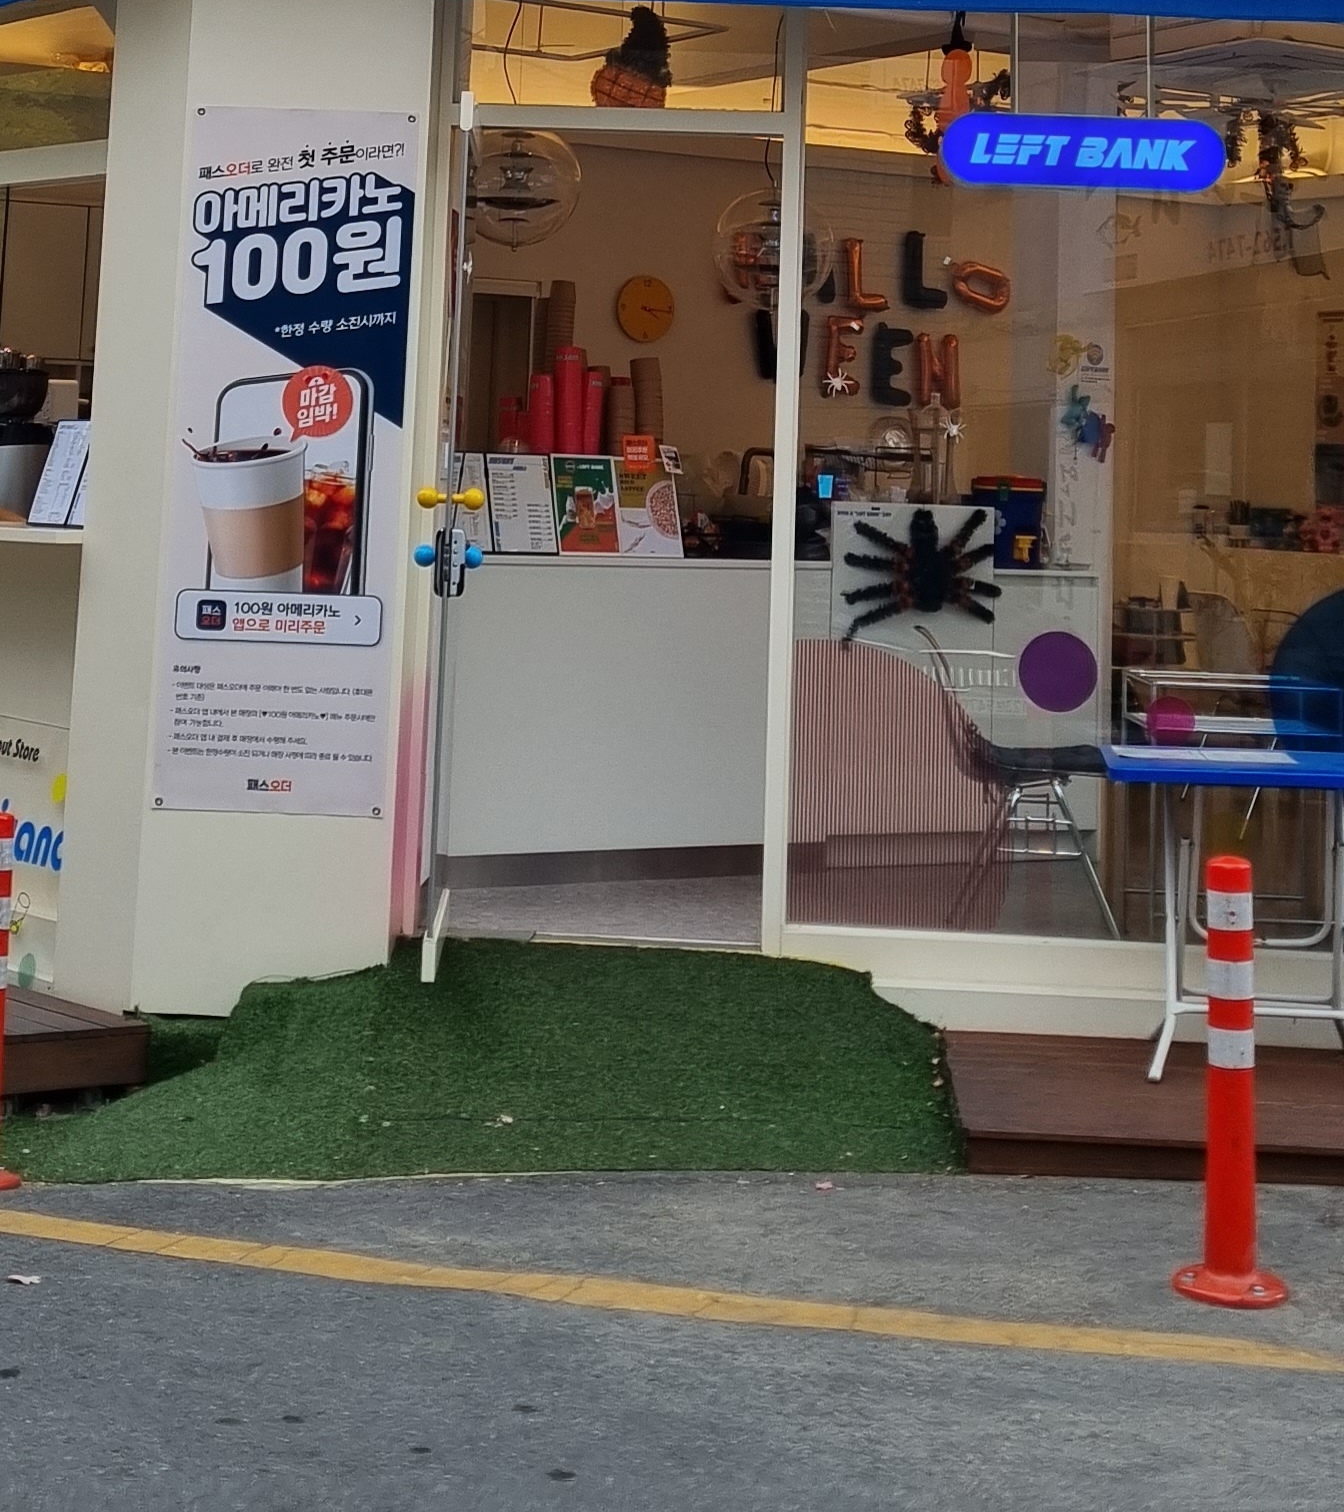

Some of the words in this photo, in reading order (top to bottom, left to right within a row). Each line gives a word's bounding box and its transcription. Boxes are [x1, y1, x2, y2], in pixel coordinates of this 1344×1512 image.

[198, 160, 264, 180] 패스오더로
[267, 156, 294, 173] 완전
[297, 148, 316, 169] 첫
[319, 142, 406, 167] 주문이라면?!
[969, 132, 1072, 167] LEFT
[1075, 136, 1198, 172] BANK
[194, 172, 404, 234] 아메리카노
[191, 215, 404, 306] 100원
[307, 318, 334, 335] 수량
[335, 311, 398, 332] 소진시까지
[299, 383, 337, 408] 마감
[296, 402, 339, 429] 임박!
[200, 616, 221, 627] 오더
[201, 603, 222, 616] 패스
[233, 601, 274, 617] 100원
[277, 601, 342, 619] 아메리카노
[232, 617, 271, 633] 앱으로
[275, 618, 327, 635] 미리주문
[12, 738, 41, 763] Store
[246, 778, 292, 792] 패스오더
